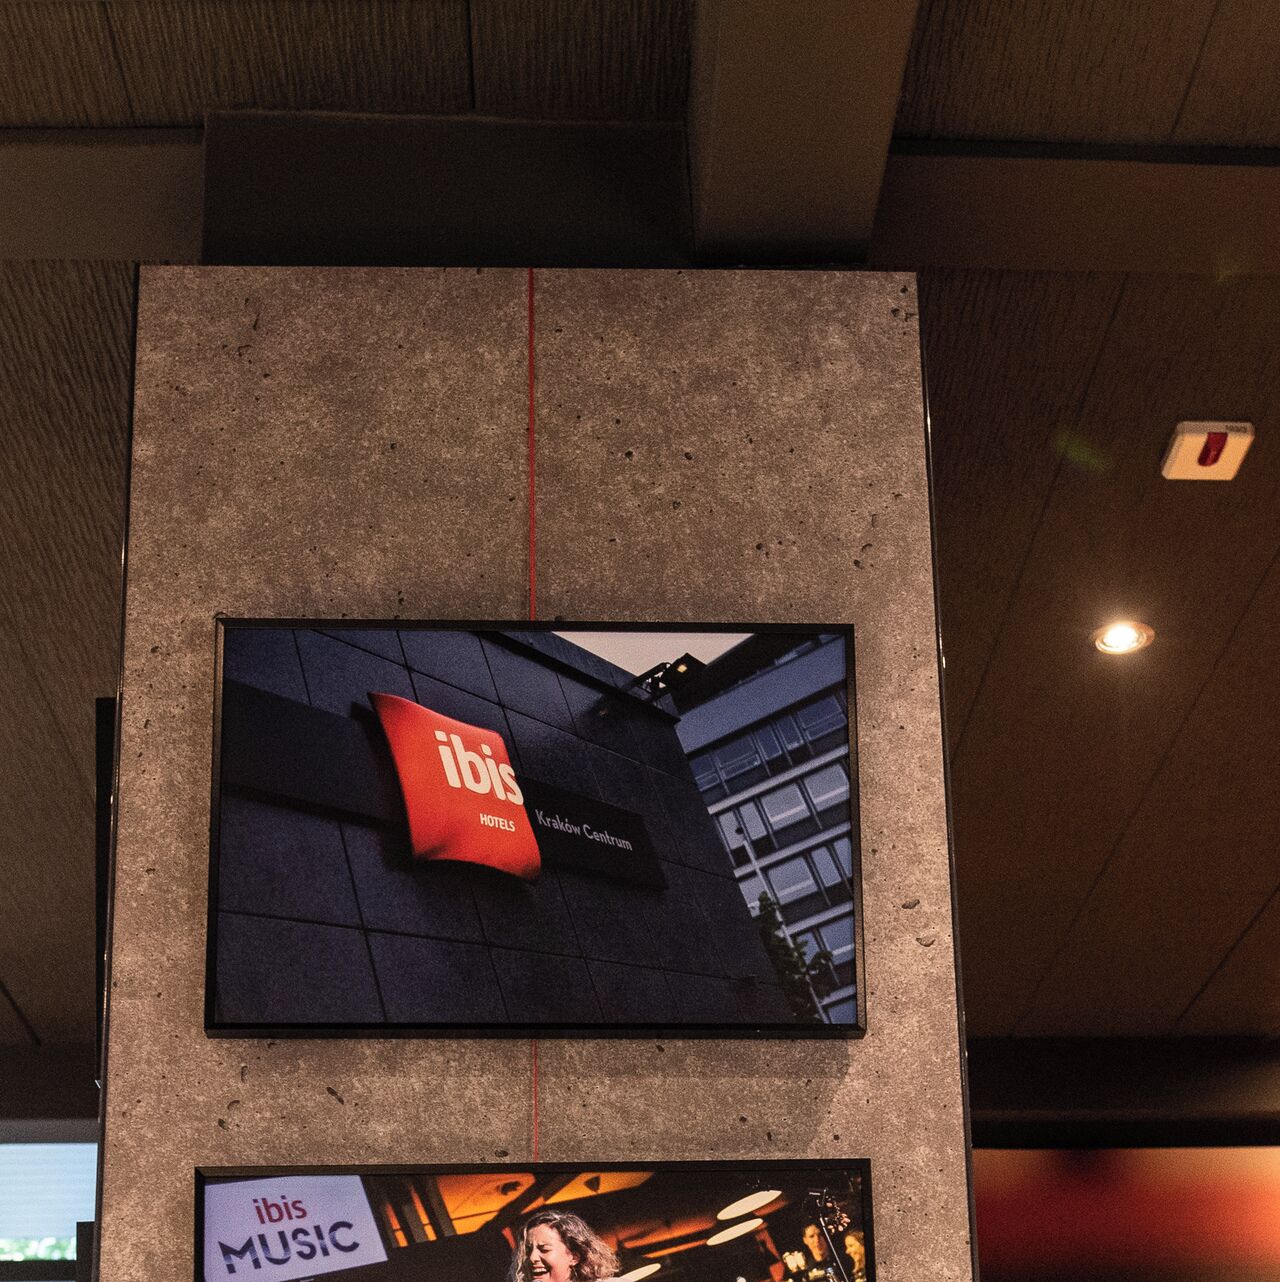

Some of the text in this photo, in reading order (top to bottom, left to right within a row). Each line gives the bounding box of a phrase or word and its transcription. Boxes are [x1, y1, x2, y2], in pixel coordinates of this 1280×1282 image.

[435, 730, 524, 805] ibis
[480, 813, 516, 832] HOTELS
[535, 809, 633, 851] Kraków Centrum
[253, 1195, 308, 1225] ibis
[218, 1220, 361, 1275] MUSIC
